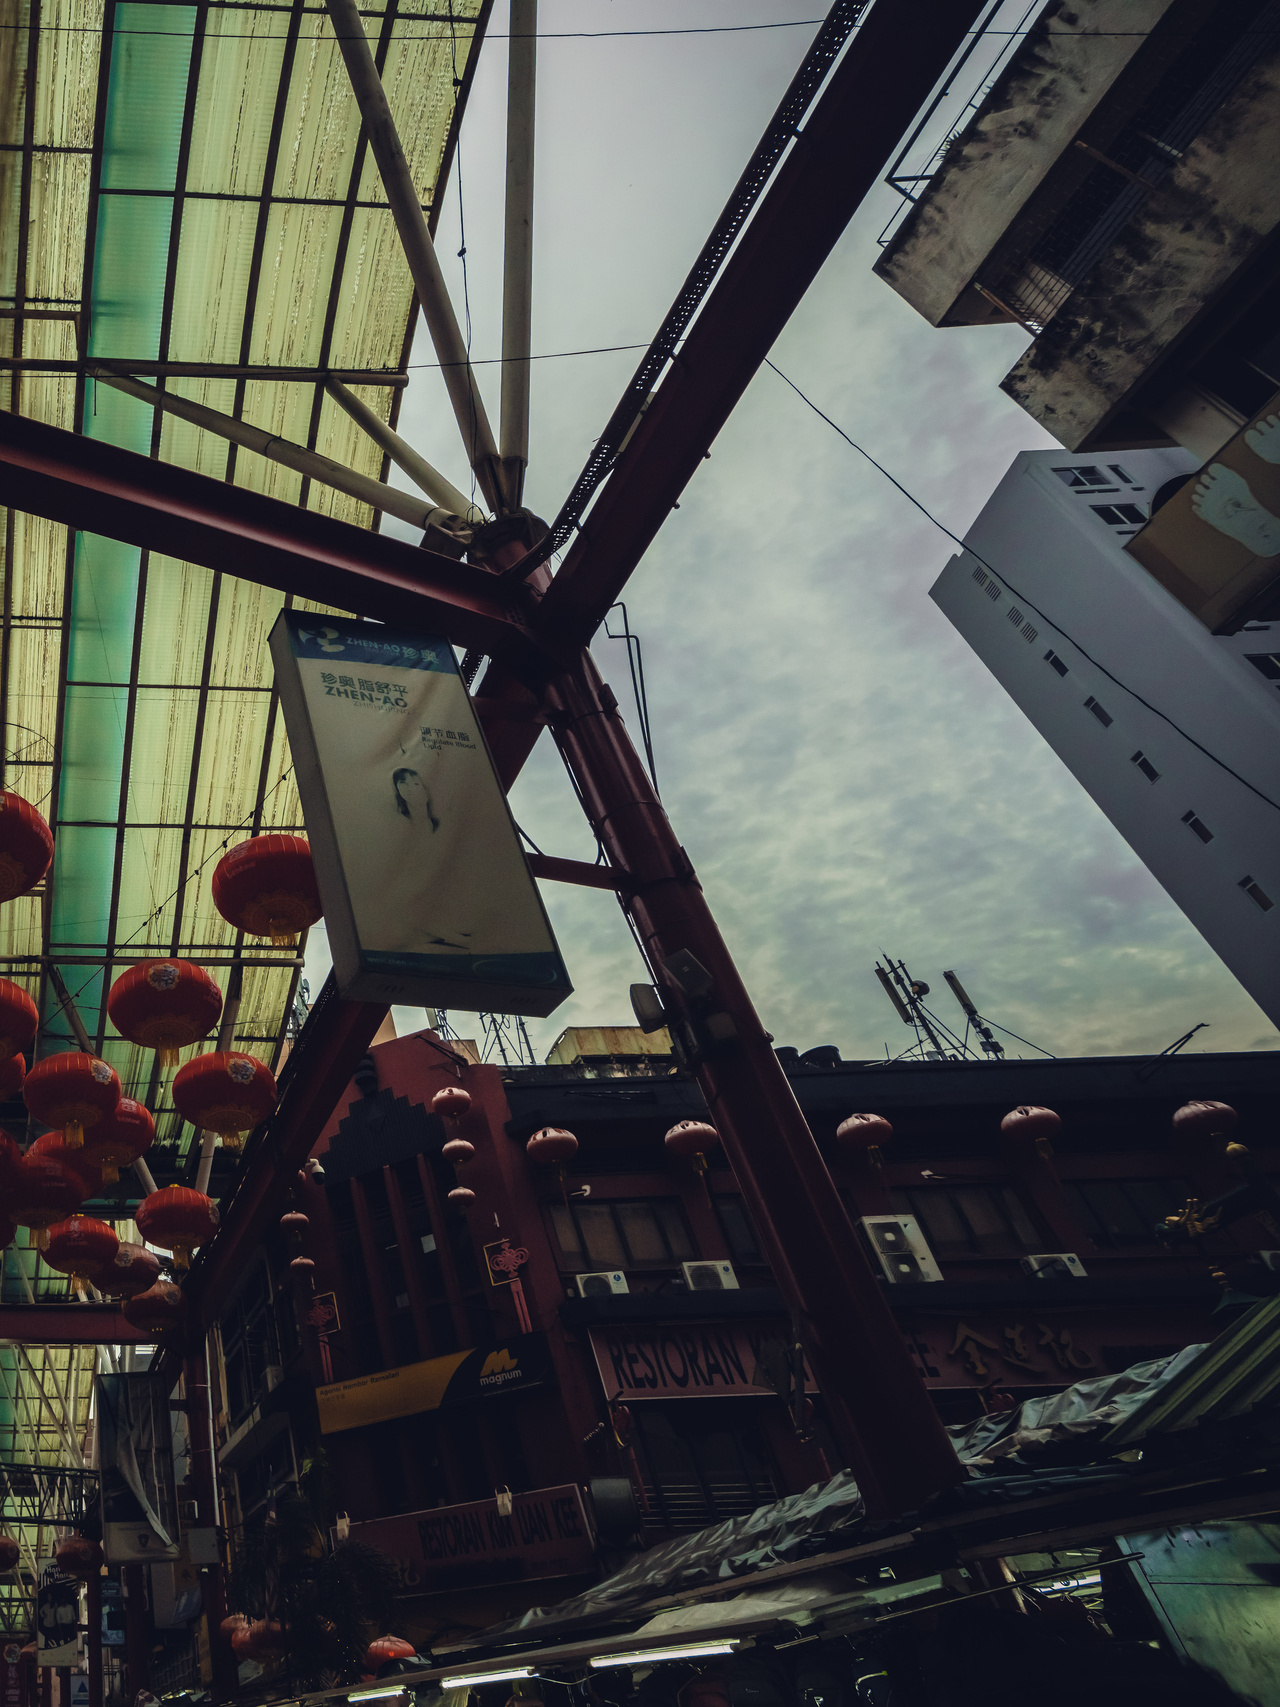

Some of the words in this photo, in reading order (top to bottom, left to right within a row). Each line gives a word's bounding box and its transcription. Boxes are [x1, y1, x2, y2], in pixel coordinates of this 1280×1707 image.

[346, 636, 400, 653] ZHEN-AO
[324, 685, 408, 708] ZHEN-AO
[606, 1331, 749, 1389] RESTORAN
[480, 1368, 522, 1386] magnum
[417, 1511, 486, 1560] RESTORAN
[485, 1508, 518, 1550] KIM
[550, 1497, 583, 1540] KEE
